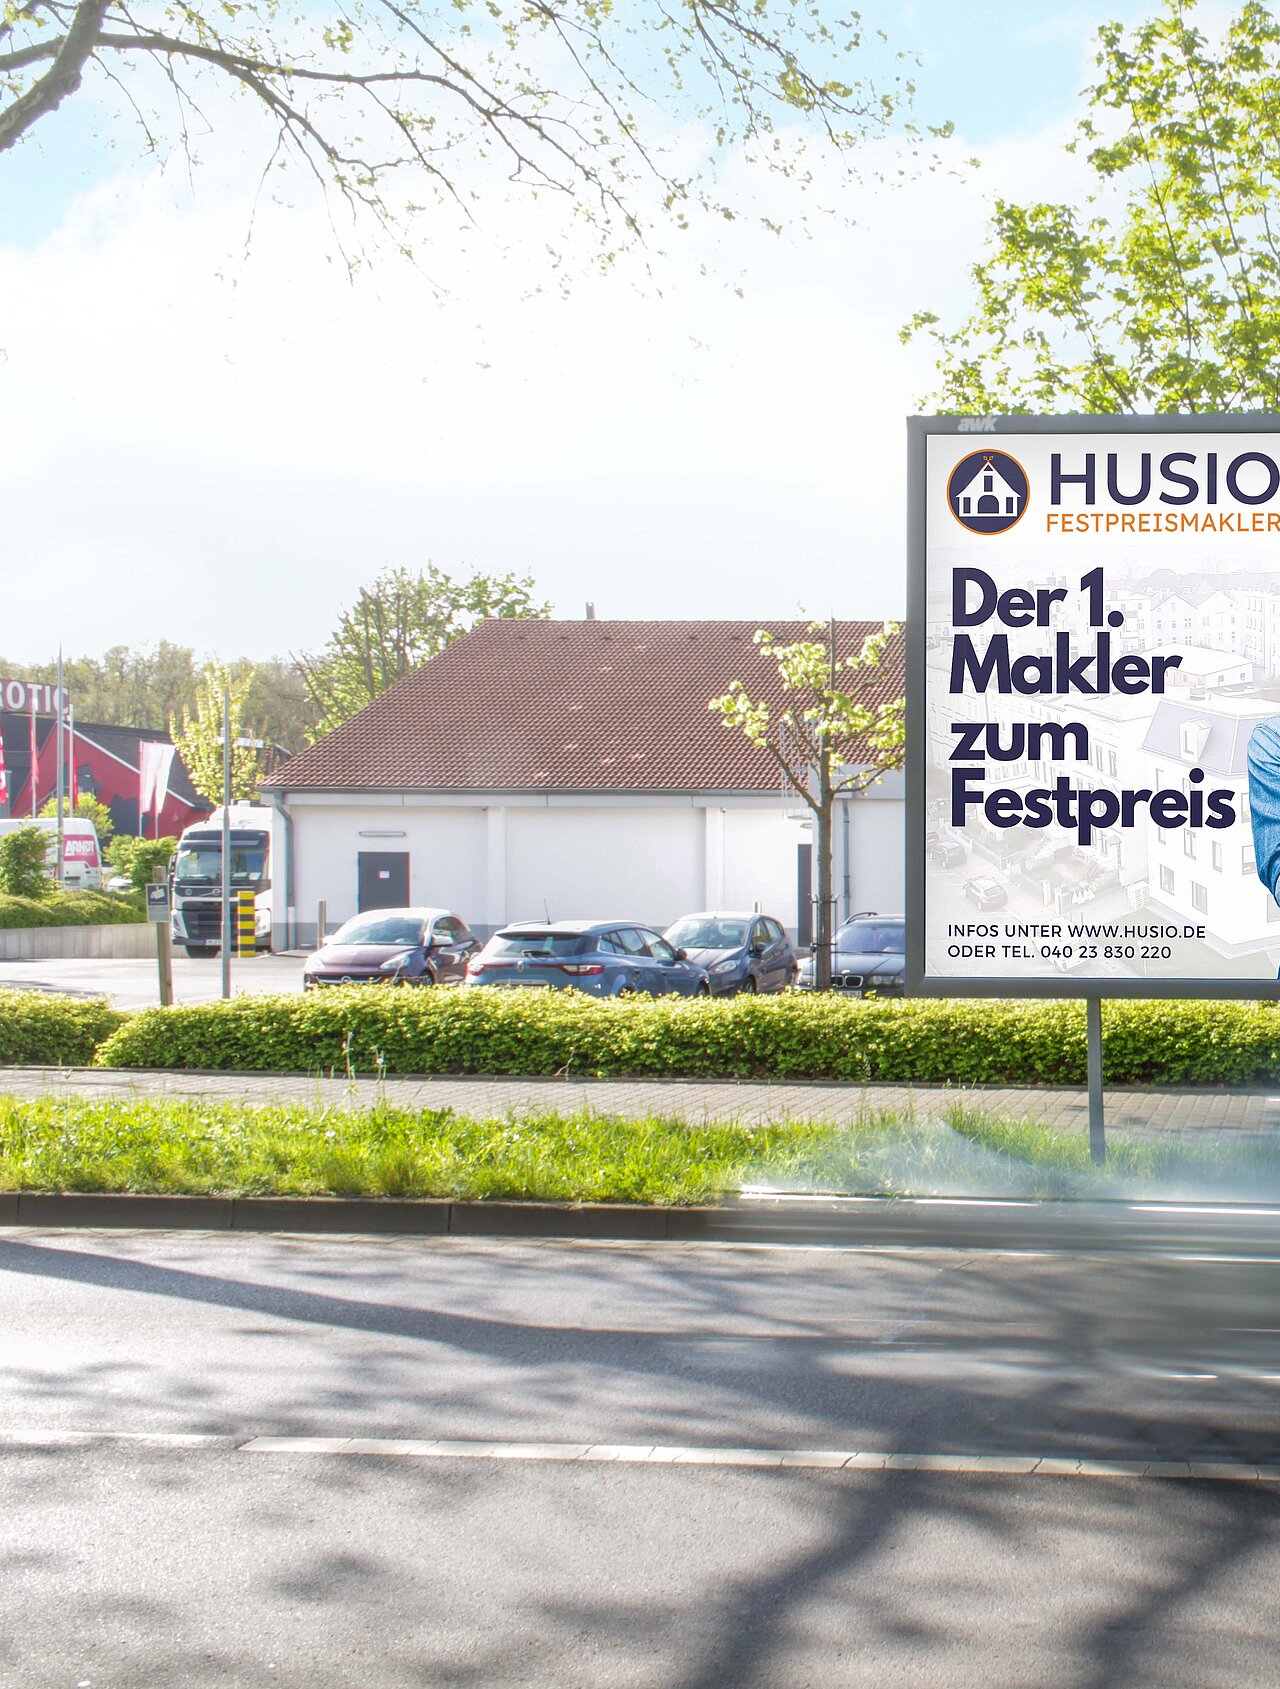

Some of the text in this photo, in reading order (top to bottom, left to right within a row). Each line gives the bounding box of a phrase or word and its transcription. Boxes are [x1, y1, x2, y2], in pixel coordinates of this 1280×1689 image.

[957, 416, 998, 432] awk
[1050, 451, 1280, 506] HUSIO
[952, 567, 1124, 628] Der 1.
[949, 632, 1183, 695] Makler
[0, 680, 69, 715] OTIC
[948, 722, 1089, 762] zum
[951, 768, 1236, 846] Festpreis
[948, 924, 1206, 939] INFOS UNTER WWW.HUSIO.DE
[947, 945, 1172, 959] ODER TEL. 040 23 830 220
